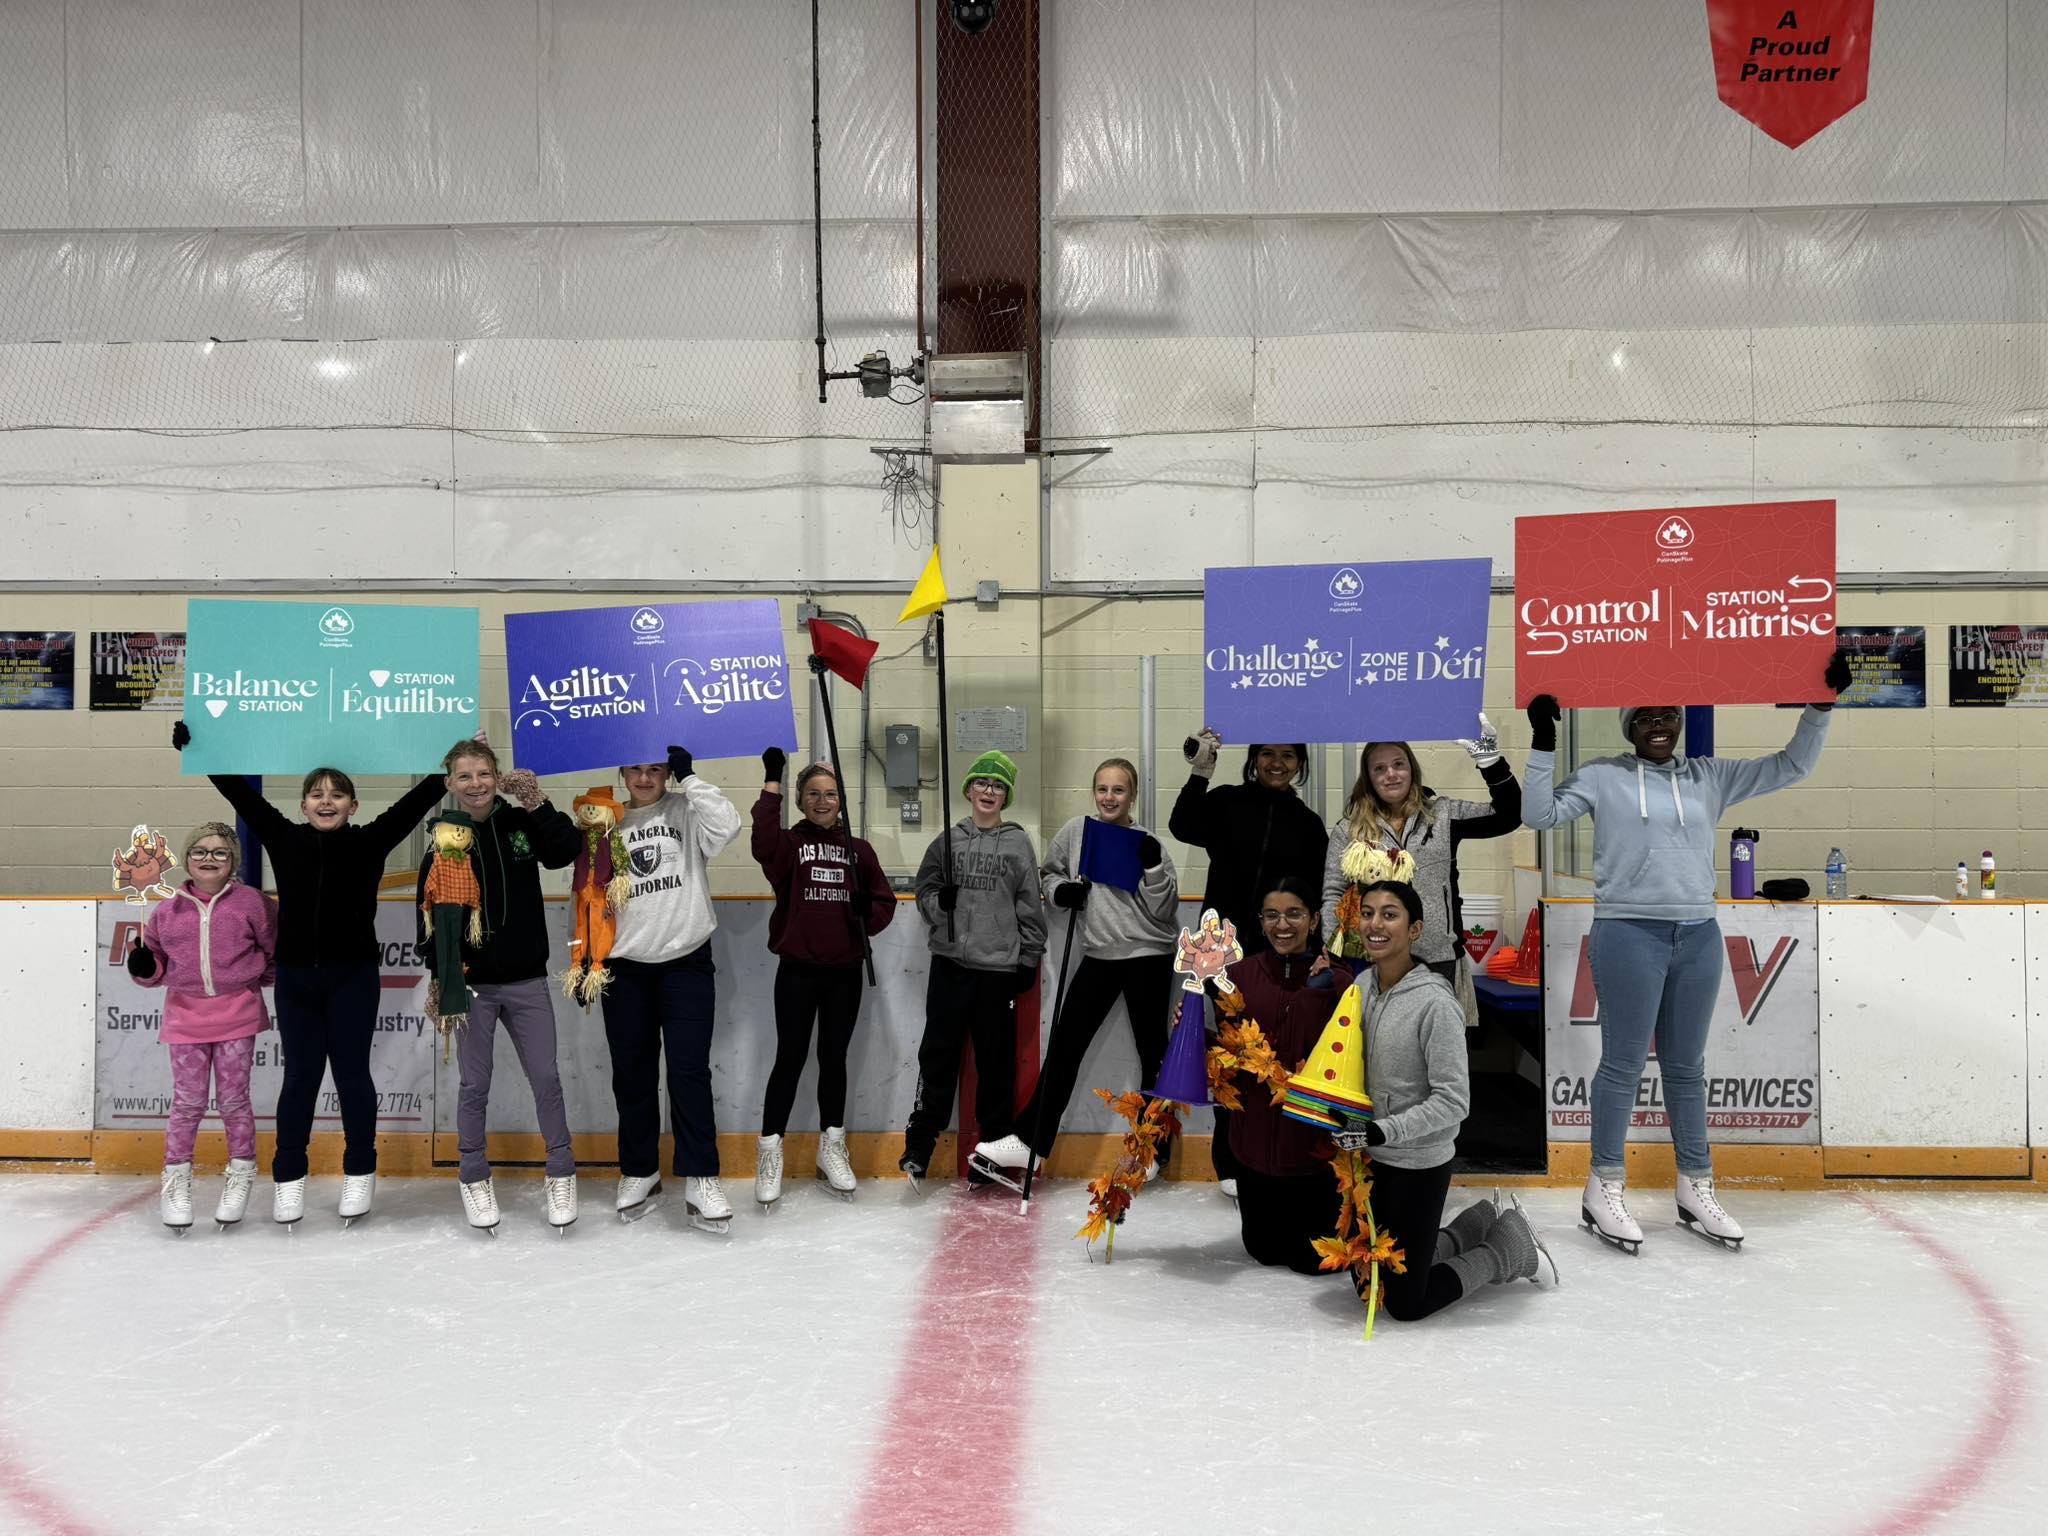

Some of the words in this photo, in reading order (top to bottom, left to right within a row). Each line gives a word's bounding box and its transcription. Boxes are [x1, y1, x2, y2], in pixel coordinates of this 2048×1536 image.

[1777, 10, 1797, 29] A
[1750, 36, 1831, 56] Proud
[1740, 63, 1841, 82] Partner
[1521, 588, 1660, 627] Control
[1706, 589, 1785, 607] STATION
[1681, 605, 1833, 641] Maîtrise
[1571, 627, 1648, 643] STATION
[710, 655, 782, 672] STATION
[1206, 643, 1345, 678] Challenge
[1360, 652, 1408, 667] ZONE
[1416, 646, 1483, 681] Défi
[192, 670, 320, 697] Balance
[394, 673, 455, 685] STATION
[1257, 672, 1307, 687] ZONE
[1384, 668, 1408, 682] DE
[520, 666, 636, 711] Agility
[674, 671, 787, 714] Agilité
[238, 700, 303, 712] STATION
[343, 683, 478, 720] Équilibre
[569, 700, 646, 719] STATION
[628, 825, 682, 843] ANGELES
[799, 843, 816, 865] LOS
[818, 843, 858, 865] ANGEL
[968, 852, 1009, 877] VEGAS
[627, 874, 682, 898] LIFORNIA
[804, 887, 850, 902] CALIFORNIA
[1704, 1078, 1814, 1108] ERVICES
[1645, 1113, 1664, 1125] AB
[1707, 1114, 1799, 1127] 780.632.7774
